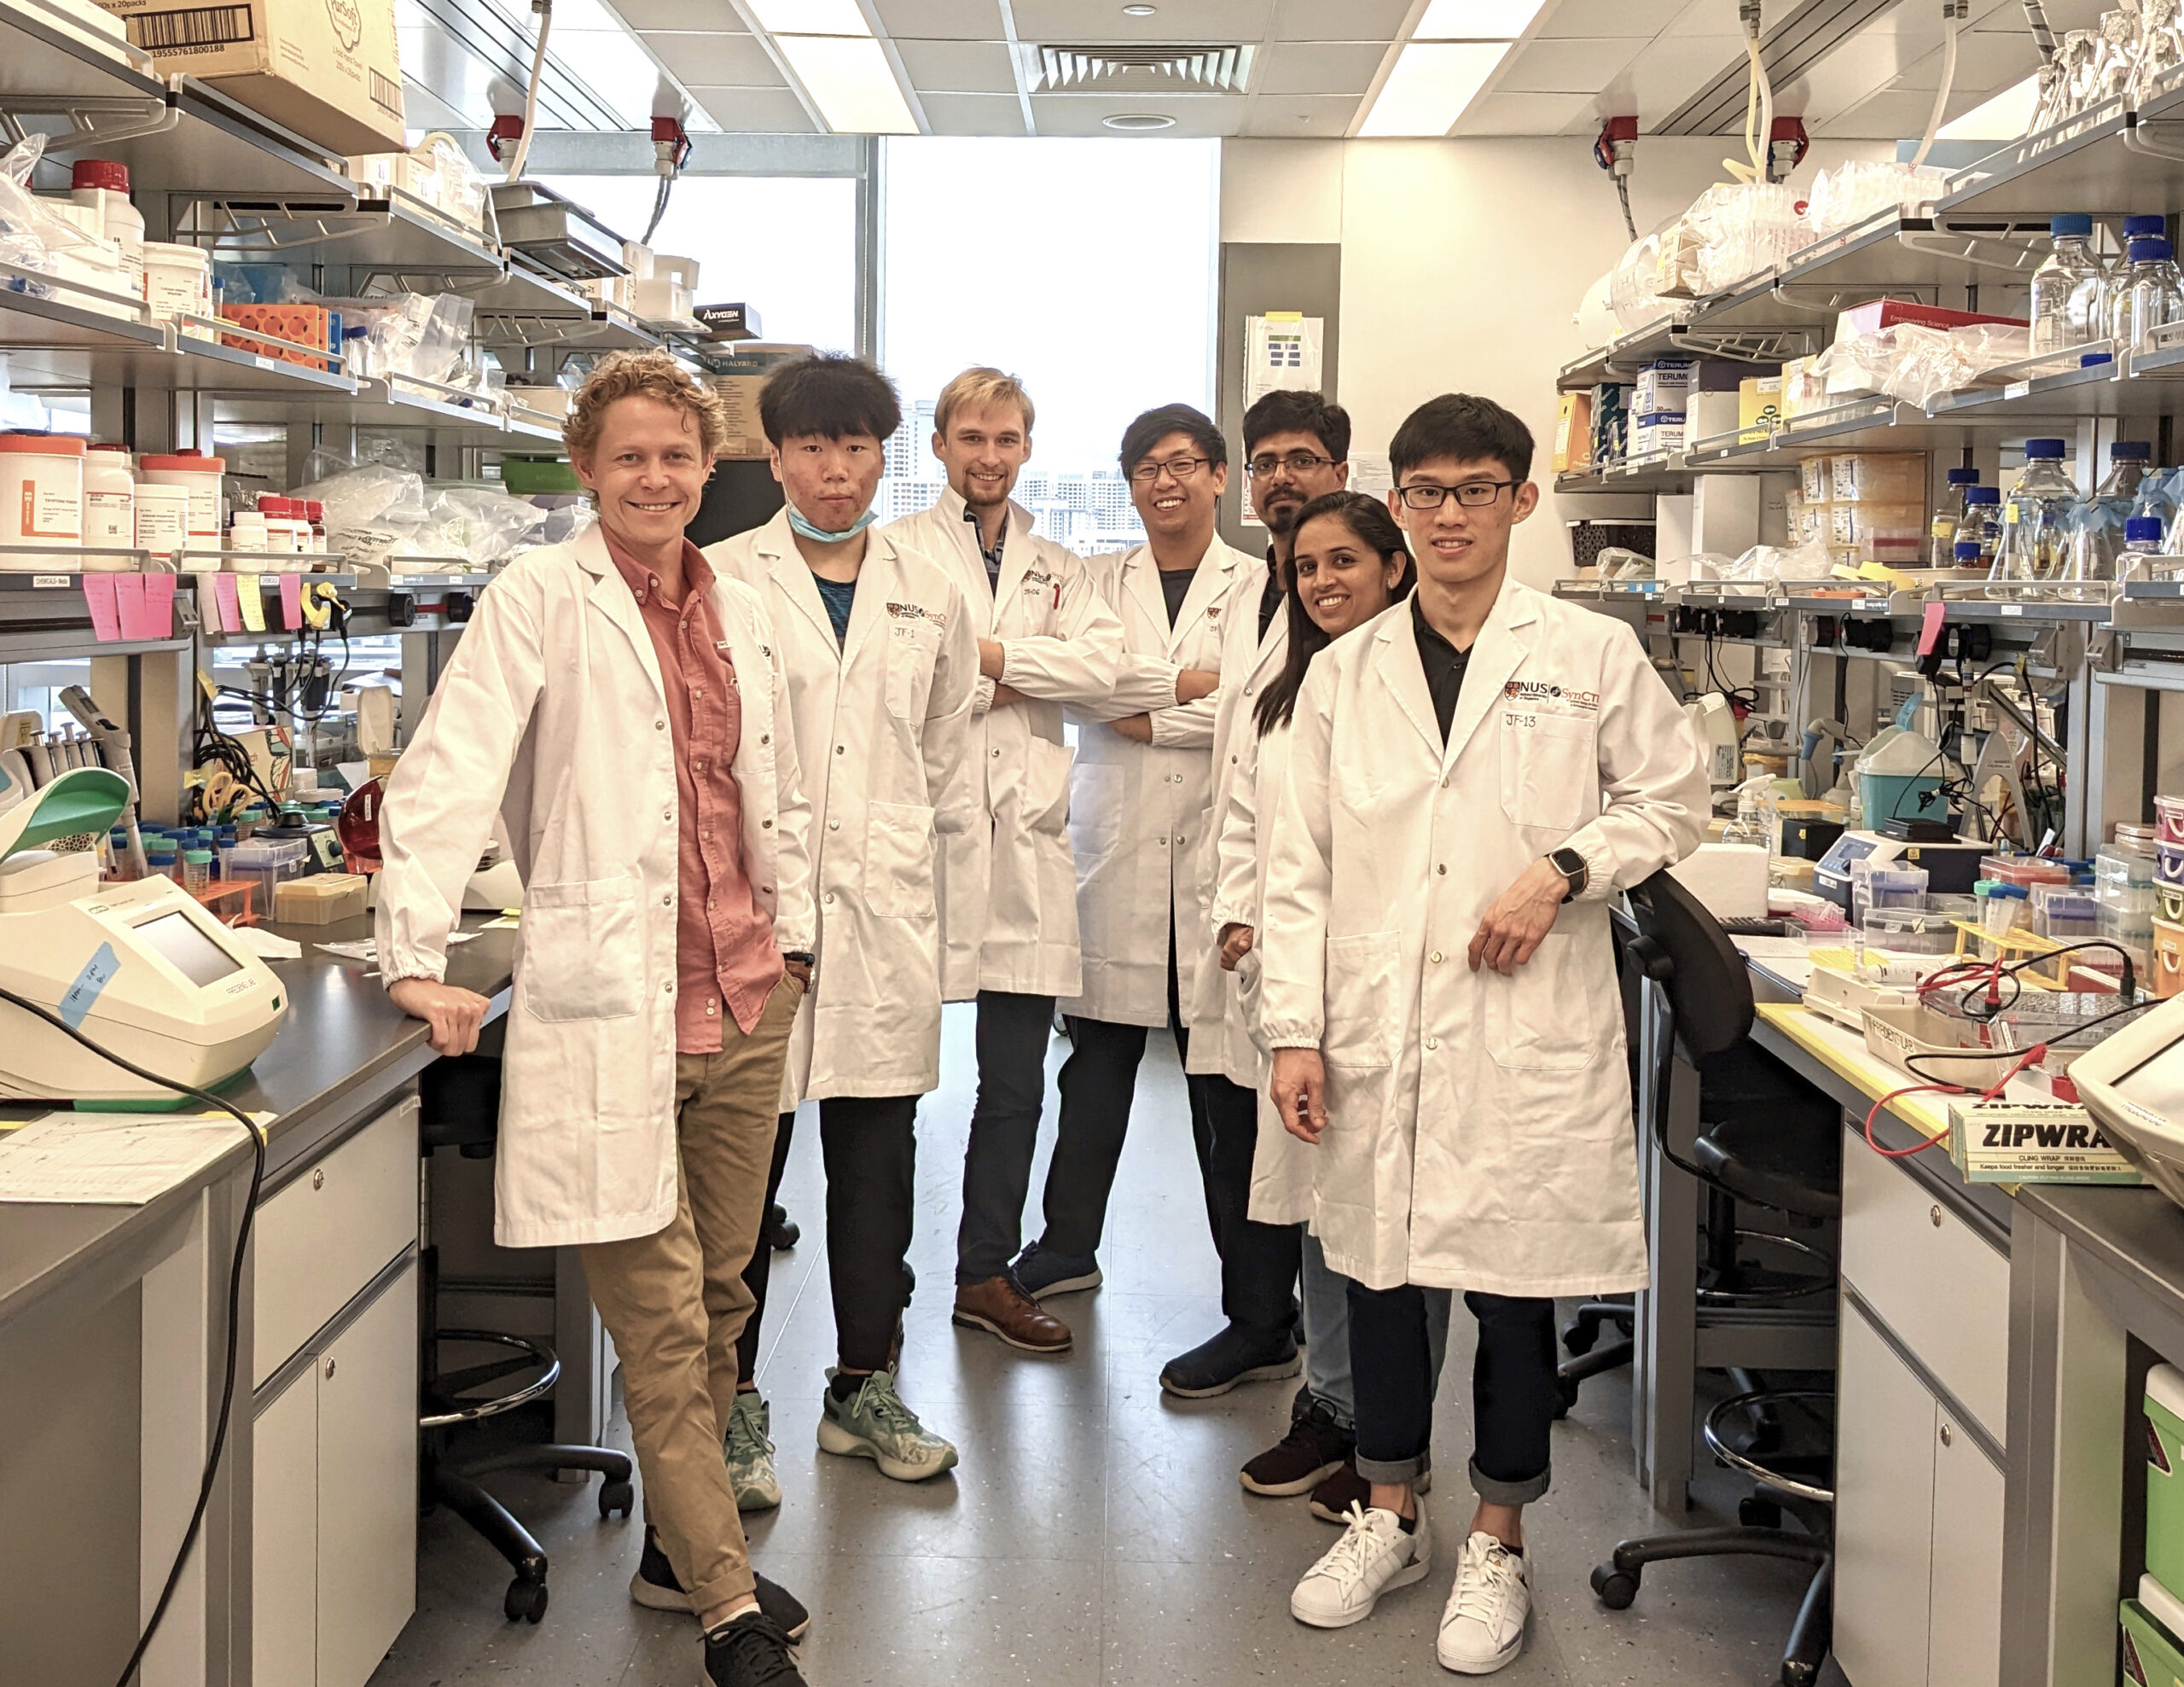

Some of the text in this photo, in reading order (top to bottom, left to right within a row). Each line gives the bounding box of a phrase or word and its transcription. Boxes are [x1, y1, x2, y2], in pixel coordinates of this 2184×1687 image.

[152, 44, 225, 58] 19555761800188
[703, 309, 740, 321] AXYGEN
[1890, 314, 1950, 329] Empowering Science
[1520, 682, 1548, 694] NUS
[1506, 713, 1536, 728] JF-13
[1982, 1123, 2114, 1149] ZIPWRA
